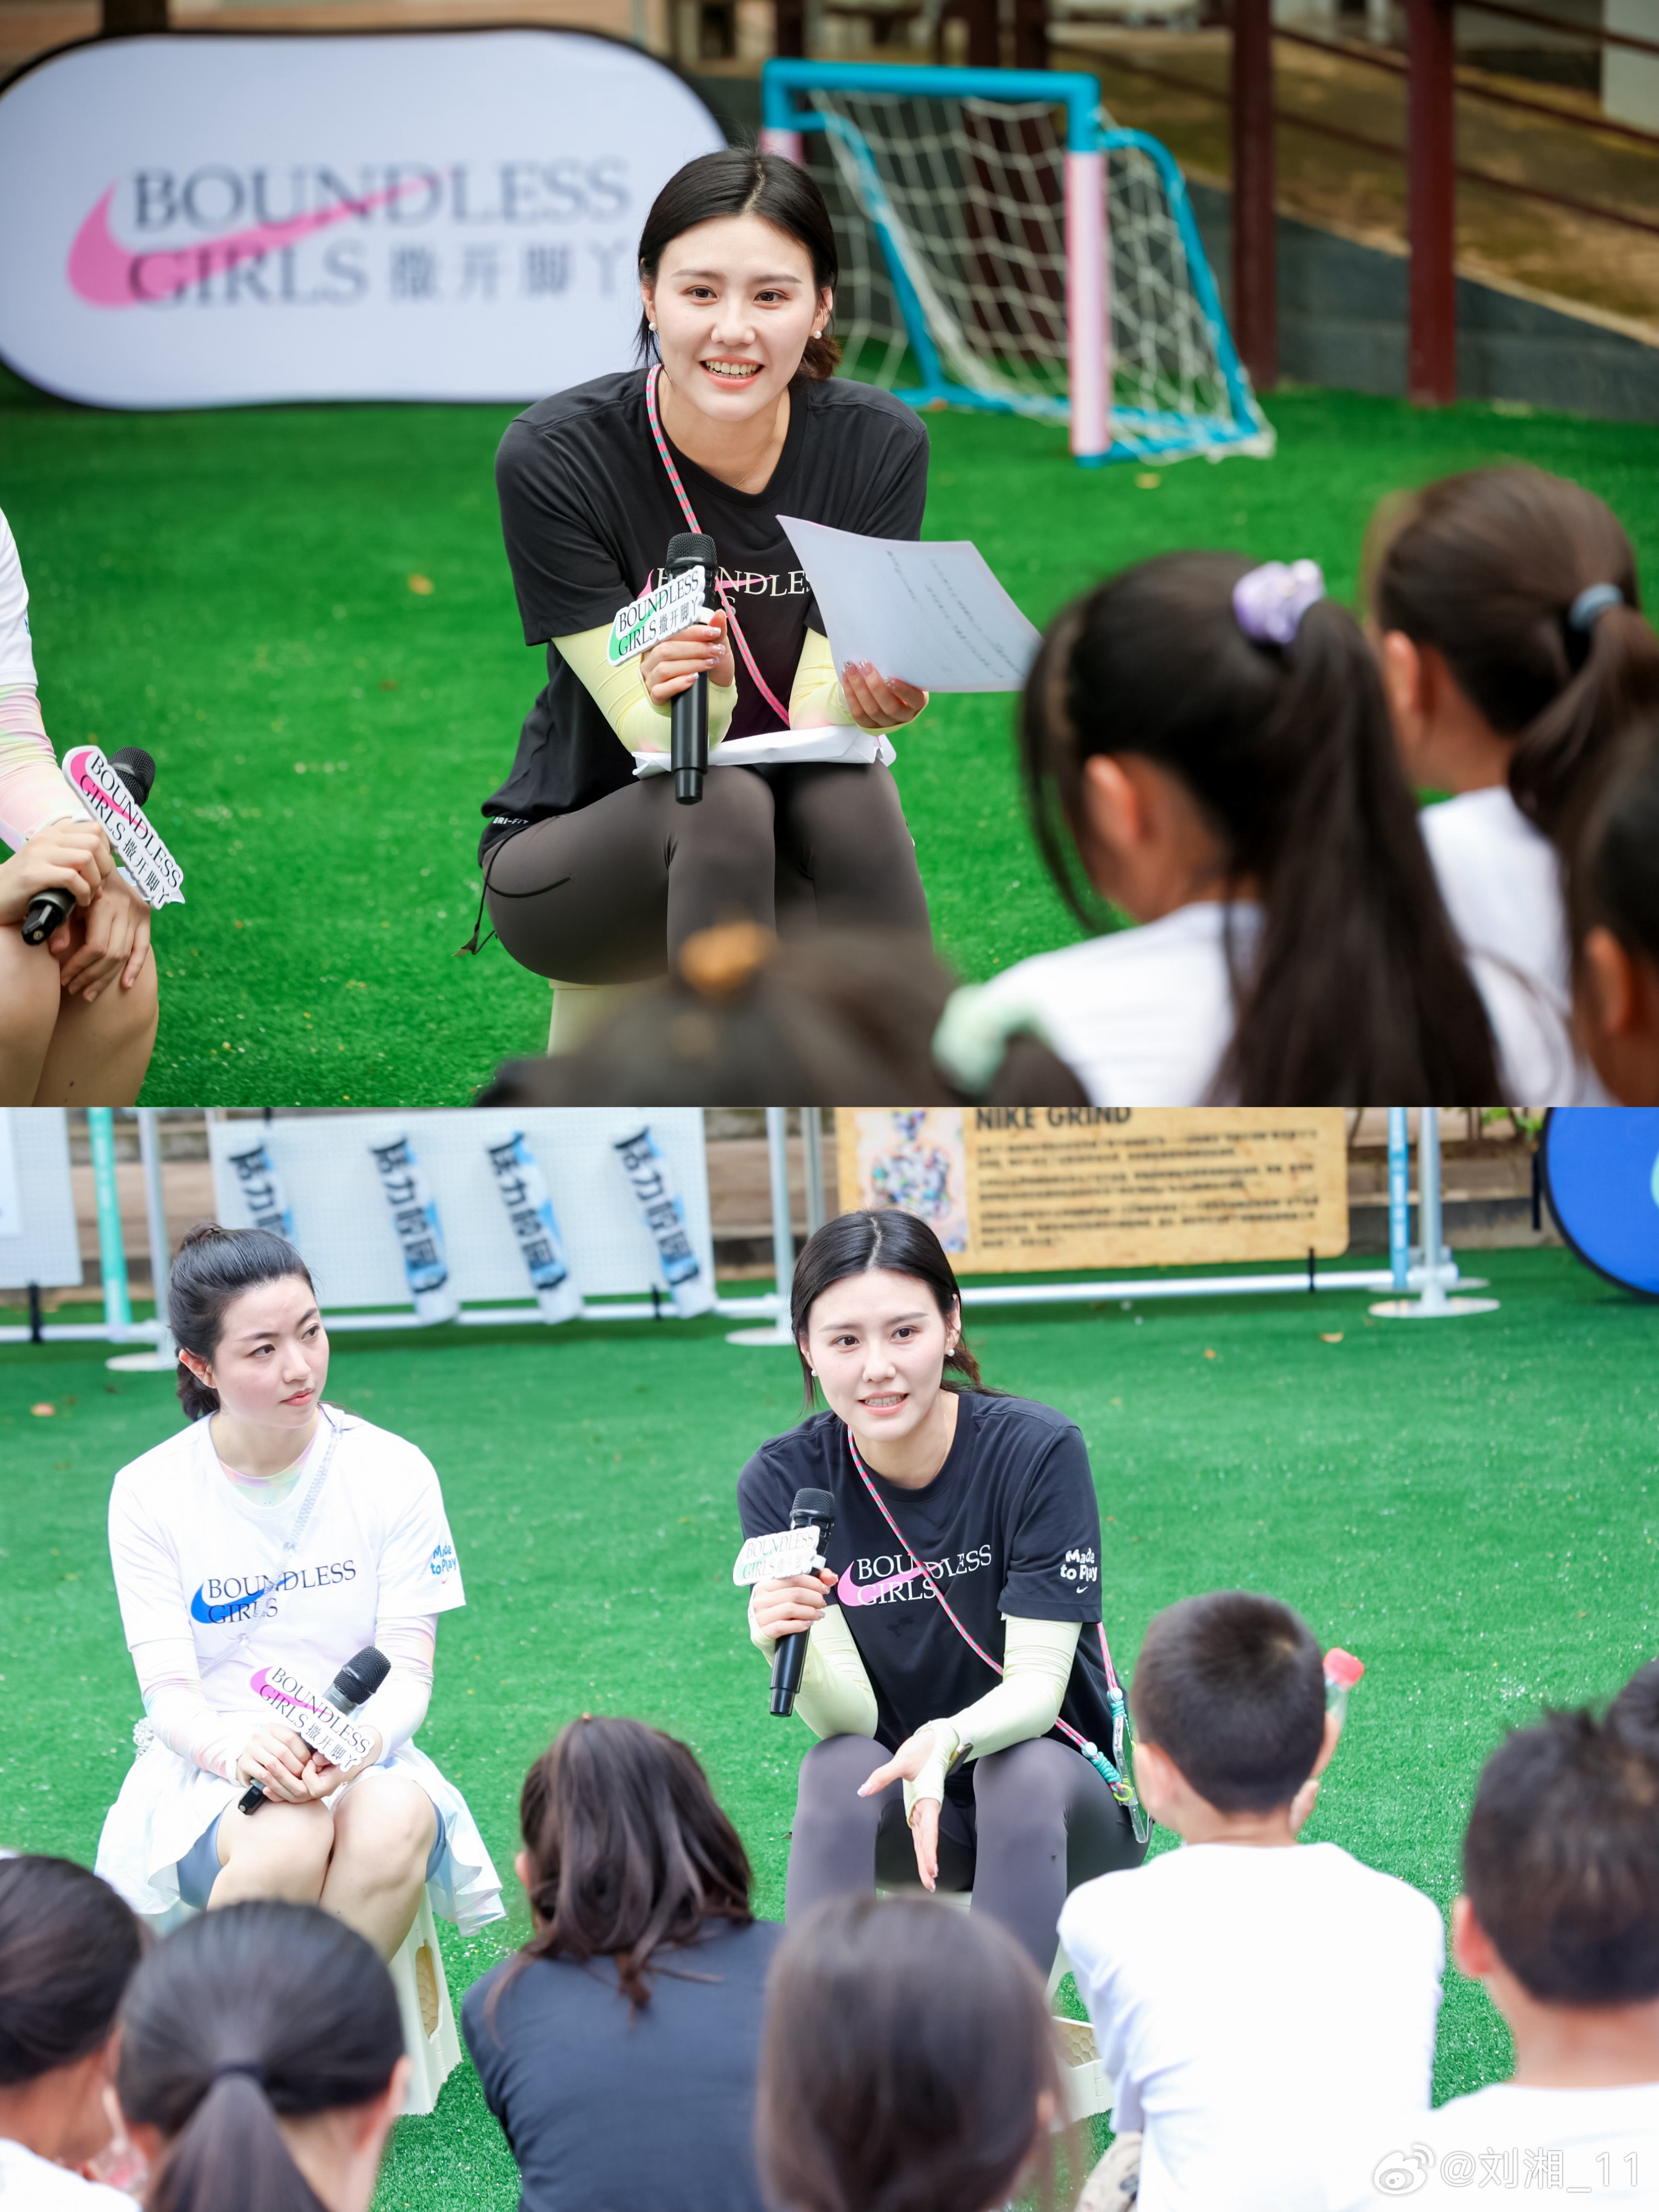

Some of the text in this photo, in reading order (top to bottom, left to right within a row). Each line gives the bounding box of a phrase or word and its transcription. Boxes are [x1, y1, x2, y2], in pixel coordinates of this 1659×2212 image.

[132, 157, 635, 234] BOUNDLESS
[129, 240, 370, 308] GIRLS
[618, 620, 657, 656] GIRLS
[659, 596, 698, 635] 撒开脚丫
[619, 570, 699, 633] BOUNDLESS
[80, 774, 170, 904] GIRLS 撒开脚丫
[90, 755, 181, 889] BOUNDLESS
[976, 1107, 1132, 1130] NIKE GRIND
[430, 1563, 441, 1575] to
[743, 1558, 776, 1579] GIRLS
[746, 1530, 814, 1559] BOUNDLESS
[1060, 1564, 1098, 1582] to Play
[1065, 1547, 1095, 1564] Made
[857, 1578, 937, 1606] GIRLS
[260, 1684, 357, 1768] GIRLS 撒开脚丫
[271, 1667, 370, 1753] BOUNDLESS
